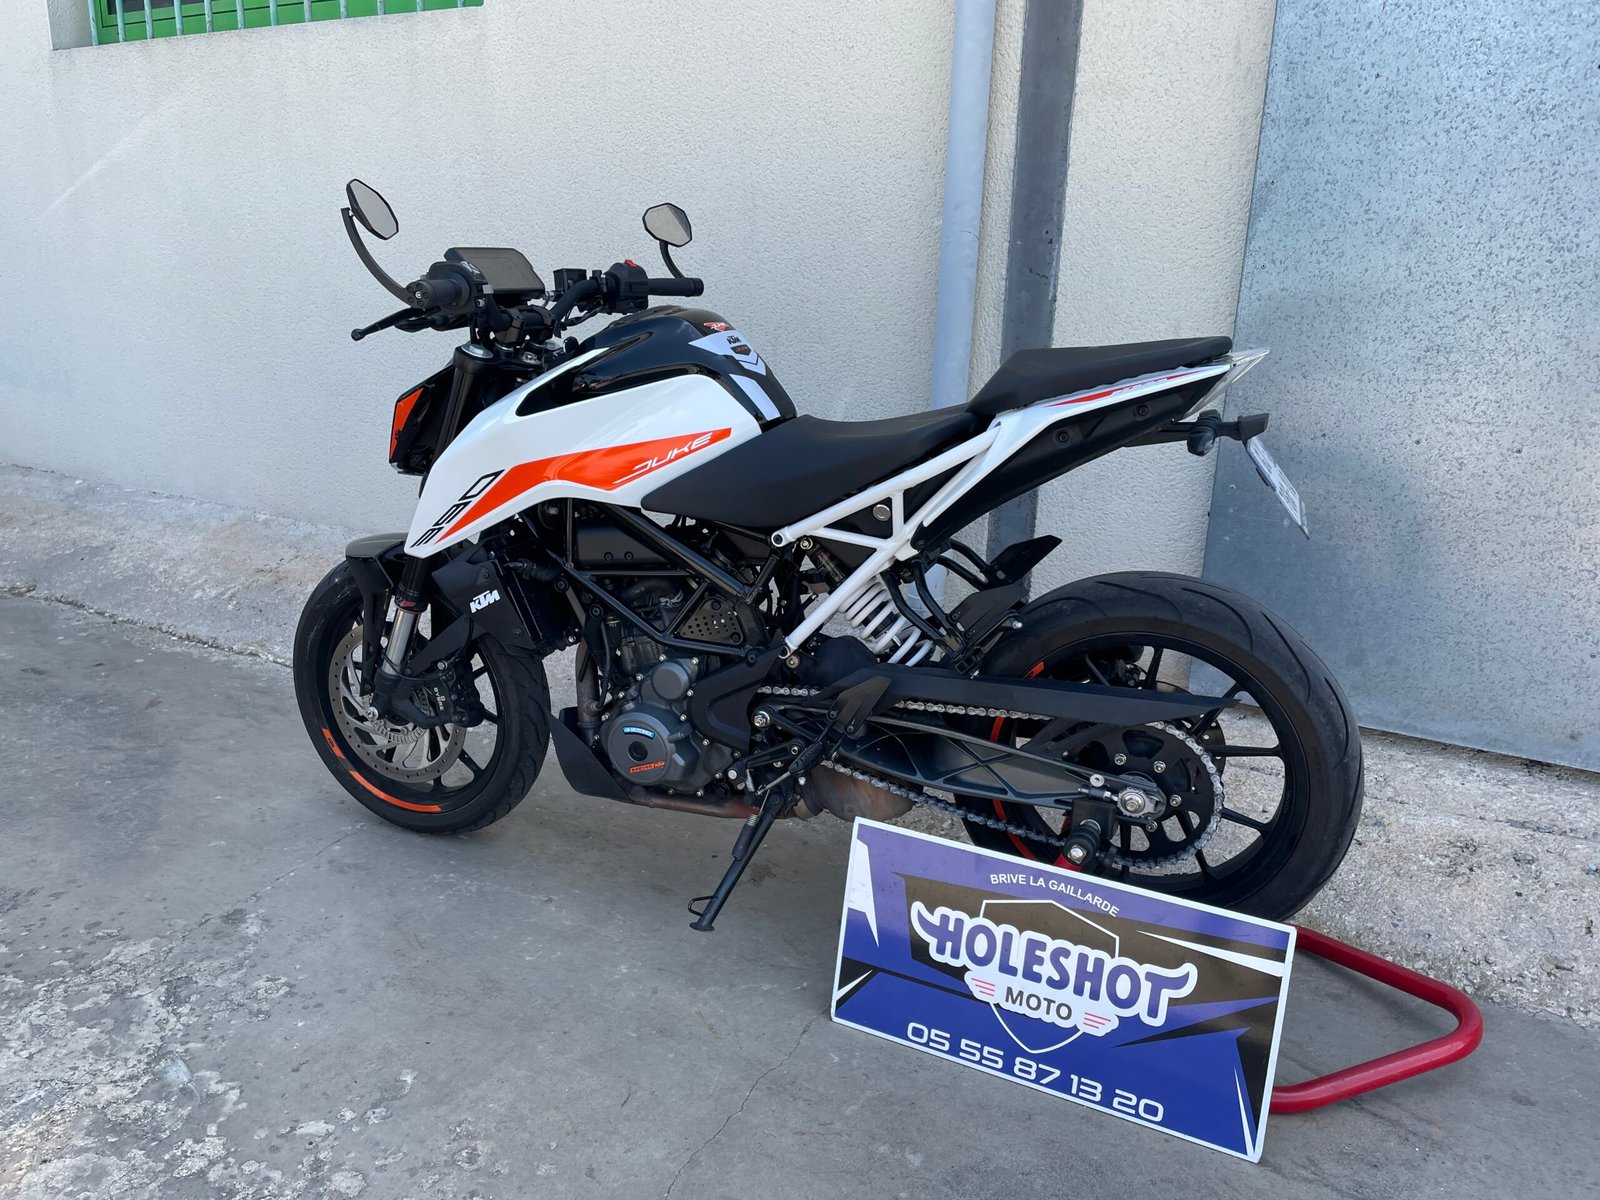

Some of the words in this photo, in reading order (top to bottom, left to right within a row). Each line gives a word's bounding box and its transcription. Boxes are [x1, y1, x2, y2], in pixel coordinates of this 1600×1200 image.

[612, 432, 713, 485] DUKE
[469, 589, 501, 614] KTM
[989, 873, 1027, 885] BRIVE
[1029, 875, 1046, 888] LA
[1048, 879, 1120, 918] GAILLARDE
[916, 907, 1191, 1020] HOLESHOT
[1004, 986, 1073, 1021] MOTO
[906, 1022, 951, 1051] 05
[959, 1038, 1004, 1069] 55
[1013, 1056, 1061, 1084] 87
[1069, 1074, 1103, 1102] 13
[1112, 1088, 1164, 1122] 20
